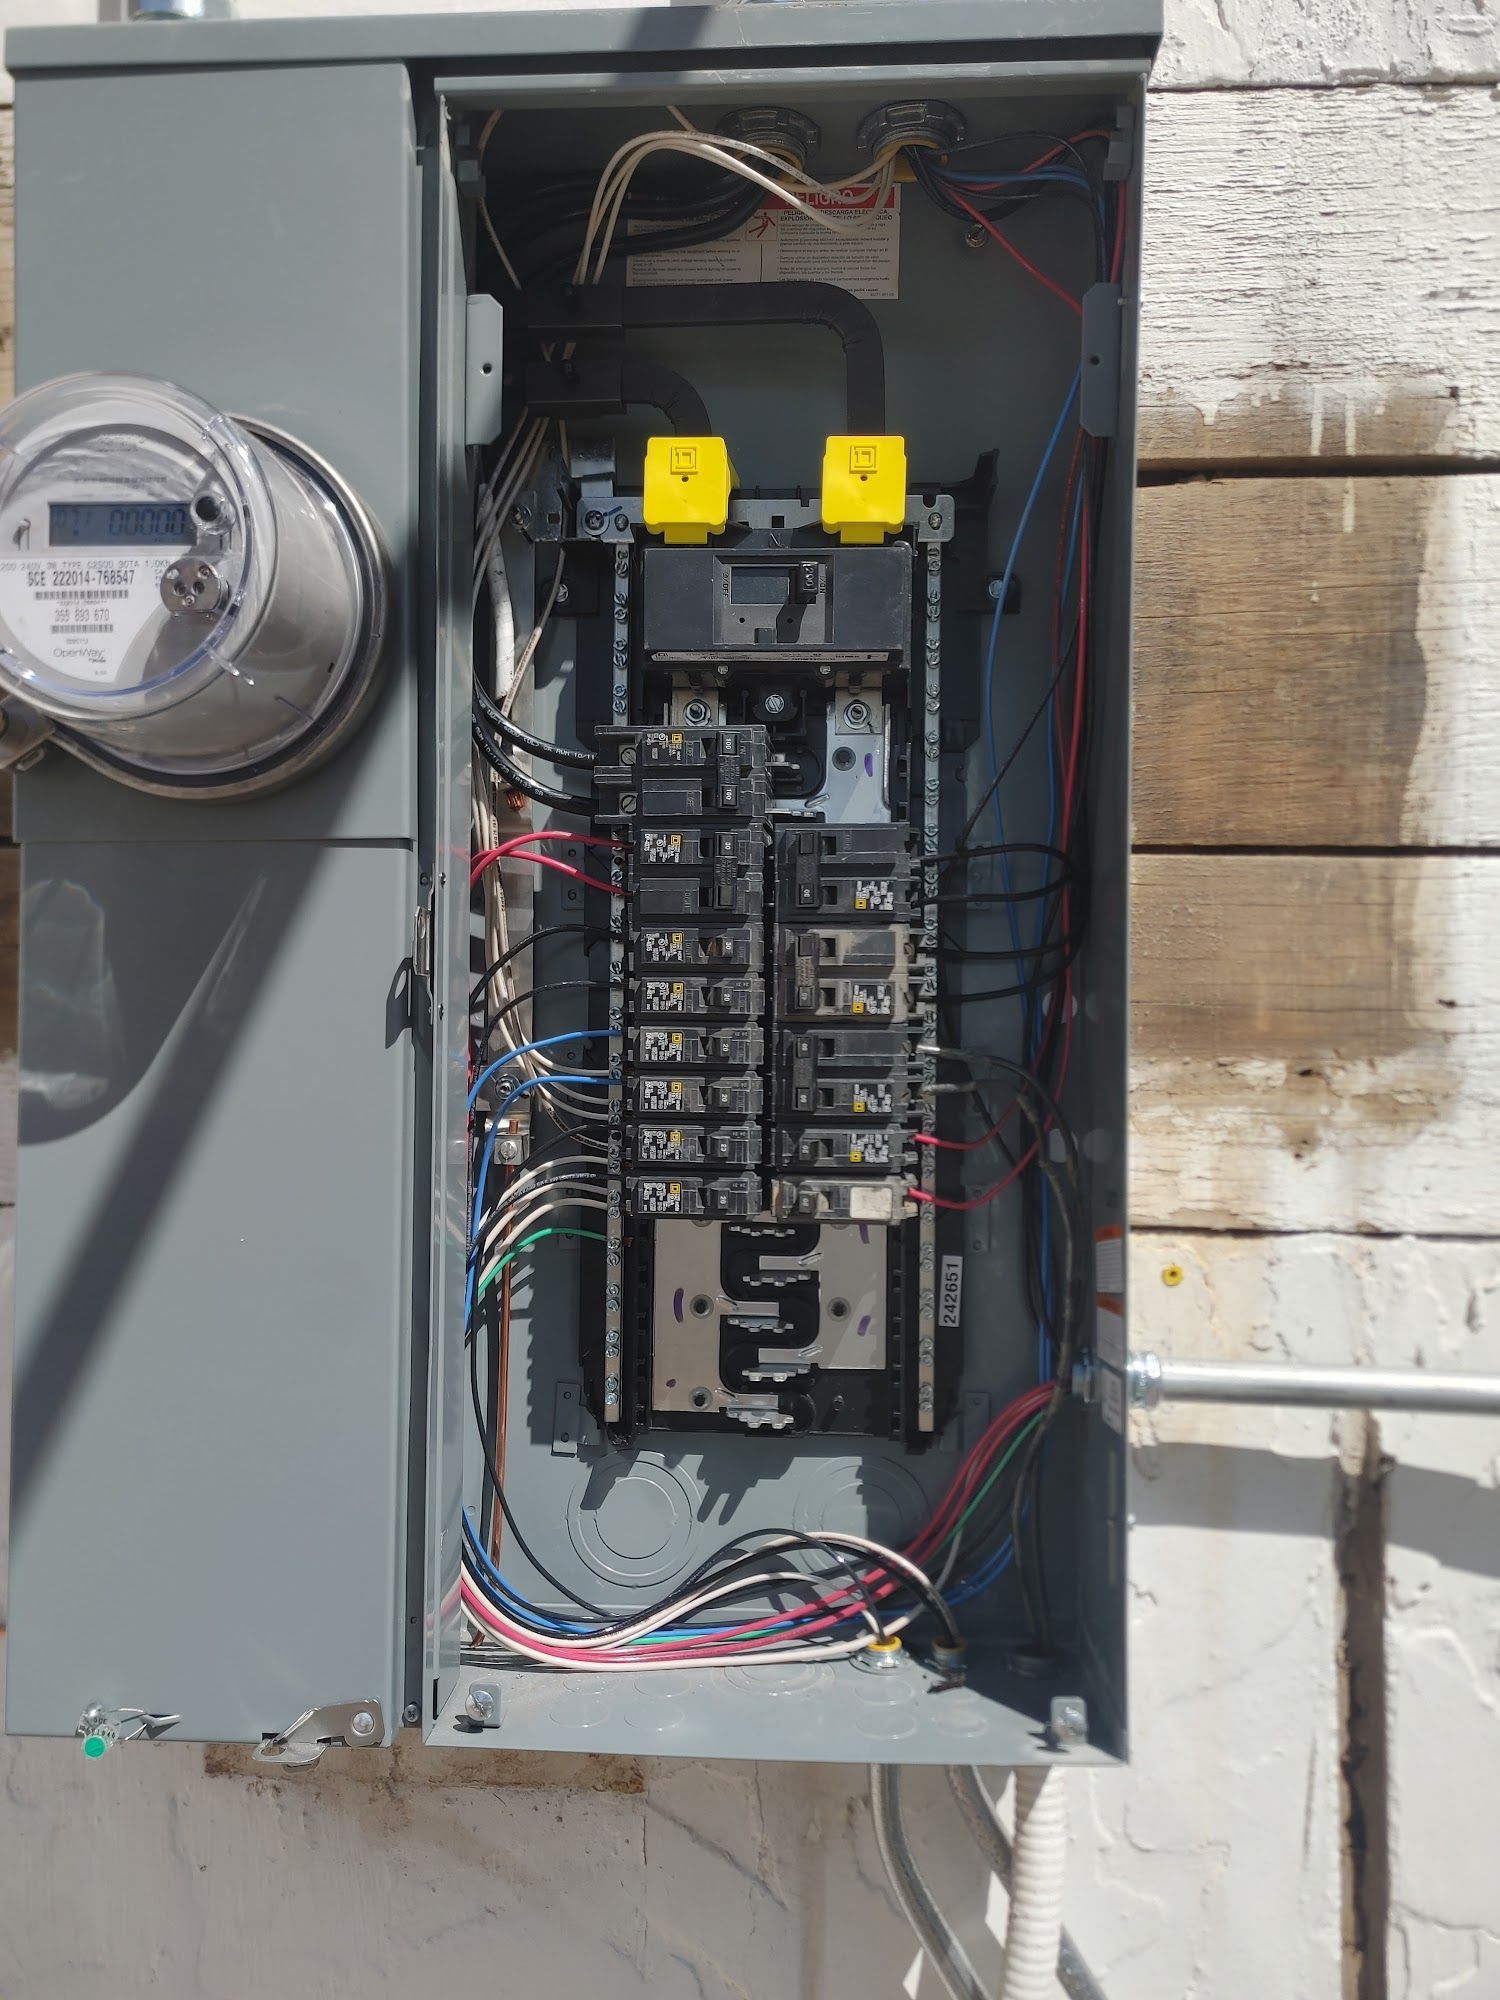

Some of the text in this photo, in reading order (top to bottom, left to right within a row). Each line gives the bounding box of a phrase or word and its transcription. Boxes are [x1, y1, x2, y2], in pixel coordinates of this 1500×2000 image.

[28, 571, 46, 587] SCE
[53, 569, 135, 587] 222014-768547
[943, 1263, 959, 1324] 242651
